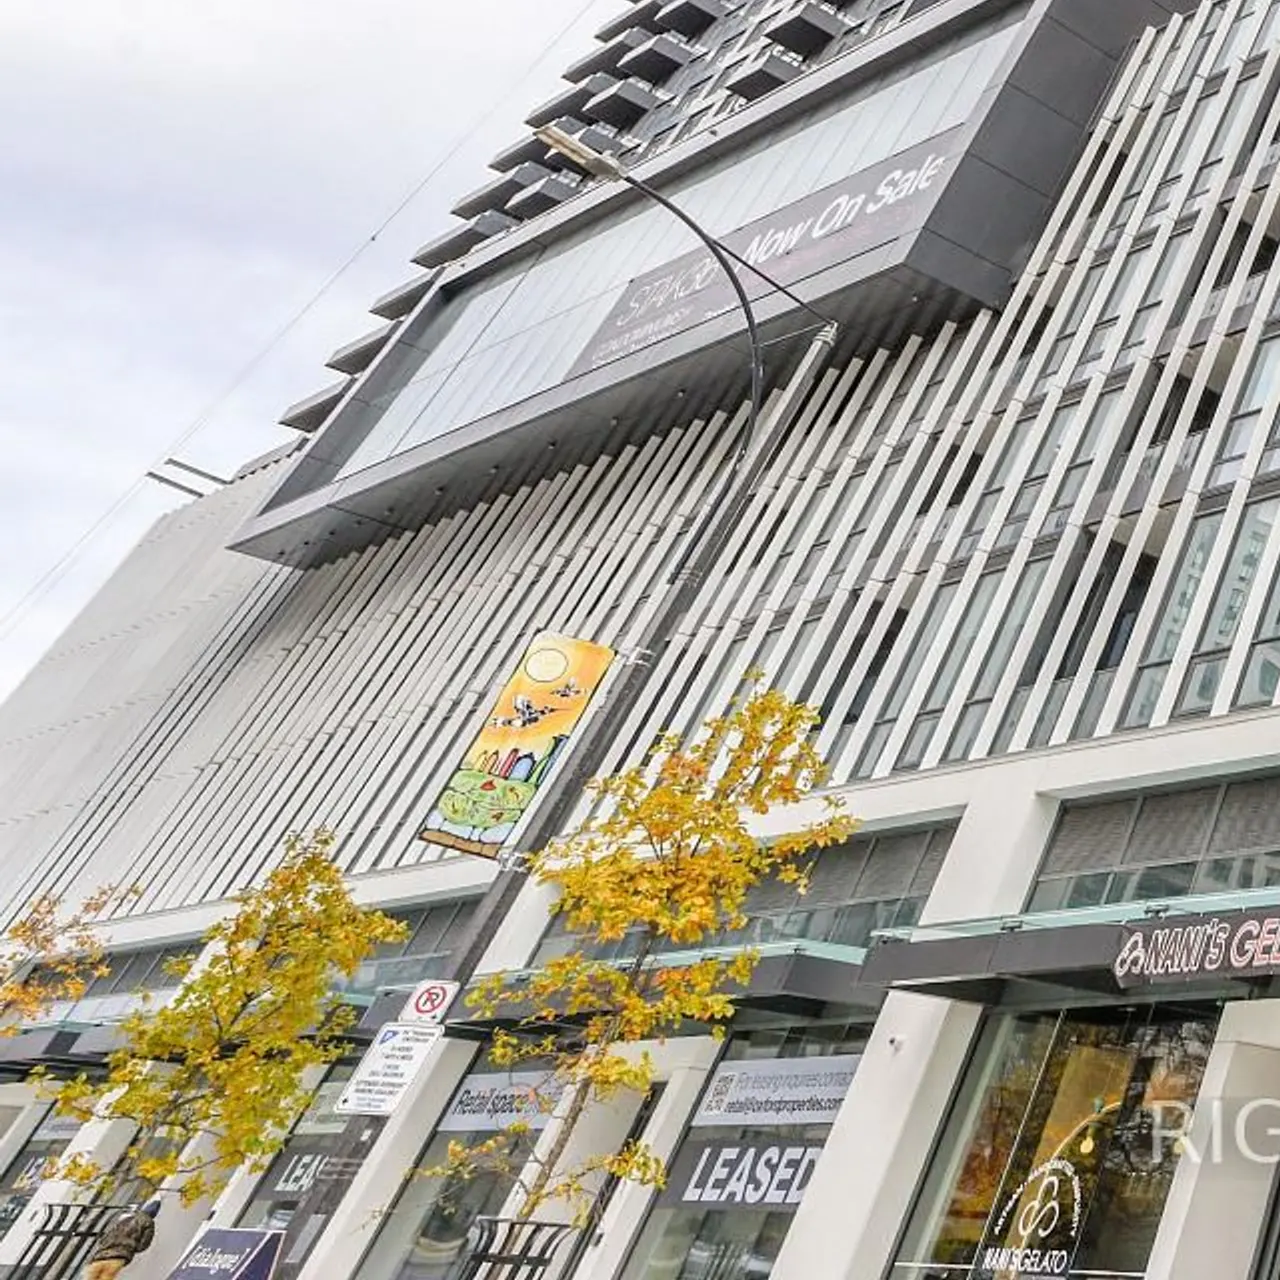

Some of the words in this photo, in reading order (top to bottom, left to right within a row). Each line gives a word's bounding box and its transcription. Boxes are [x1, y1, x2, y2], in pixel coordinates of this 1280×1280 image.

[734, 217, 813, 272] Now
[812, 194, 866, 239] On
[866, 153, 946, 214] Sale
[1144, 917, 1232, 977] NANI'S
[274, 1154, 330, 1191] LEA
[681, 1146, 825, 1204] LEASED
[1018, 1249, 1068, 1274] GELATO
